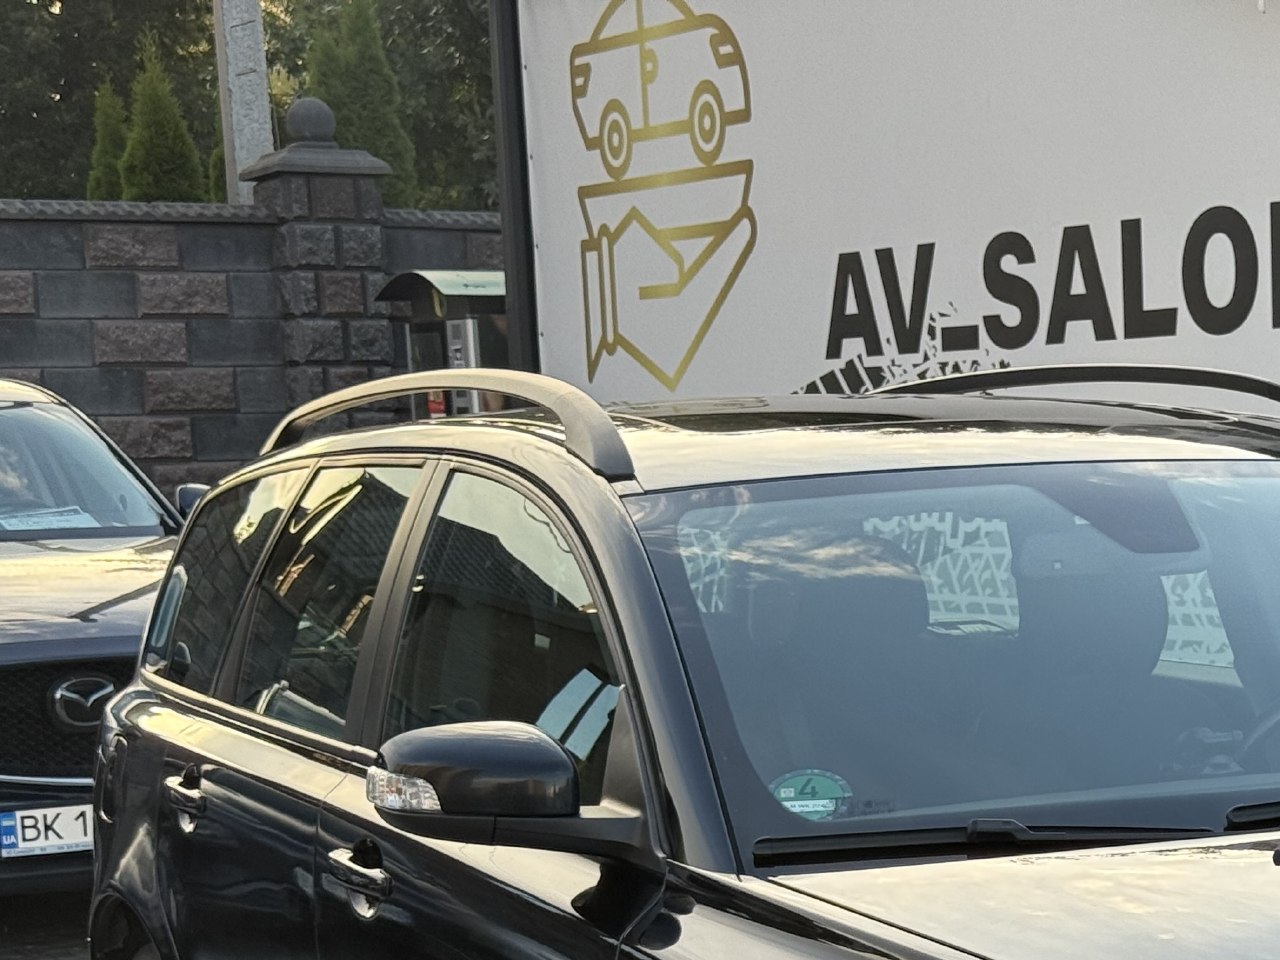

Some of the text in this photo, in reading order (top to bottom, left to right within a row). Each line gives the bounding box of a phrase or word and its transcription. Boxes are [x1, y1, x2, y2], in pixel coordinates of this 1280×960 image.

[798, 777, 819, 798] 4
[20, 813, 65, 843] BK
[2, 835, 16, 845] UA
